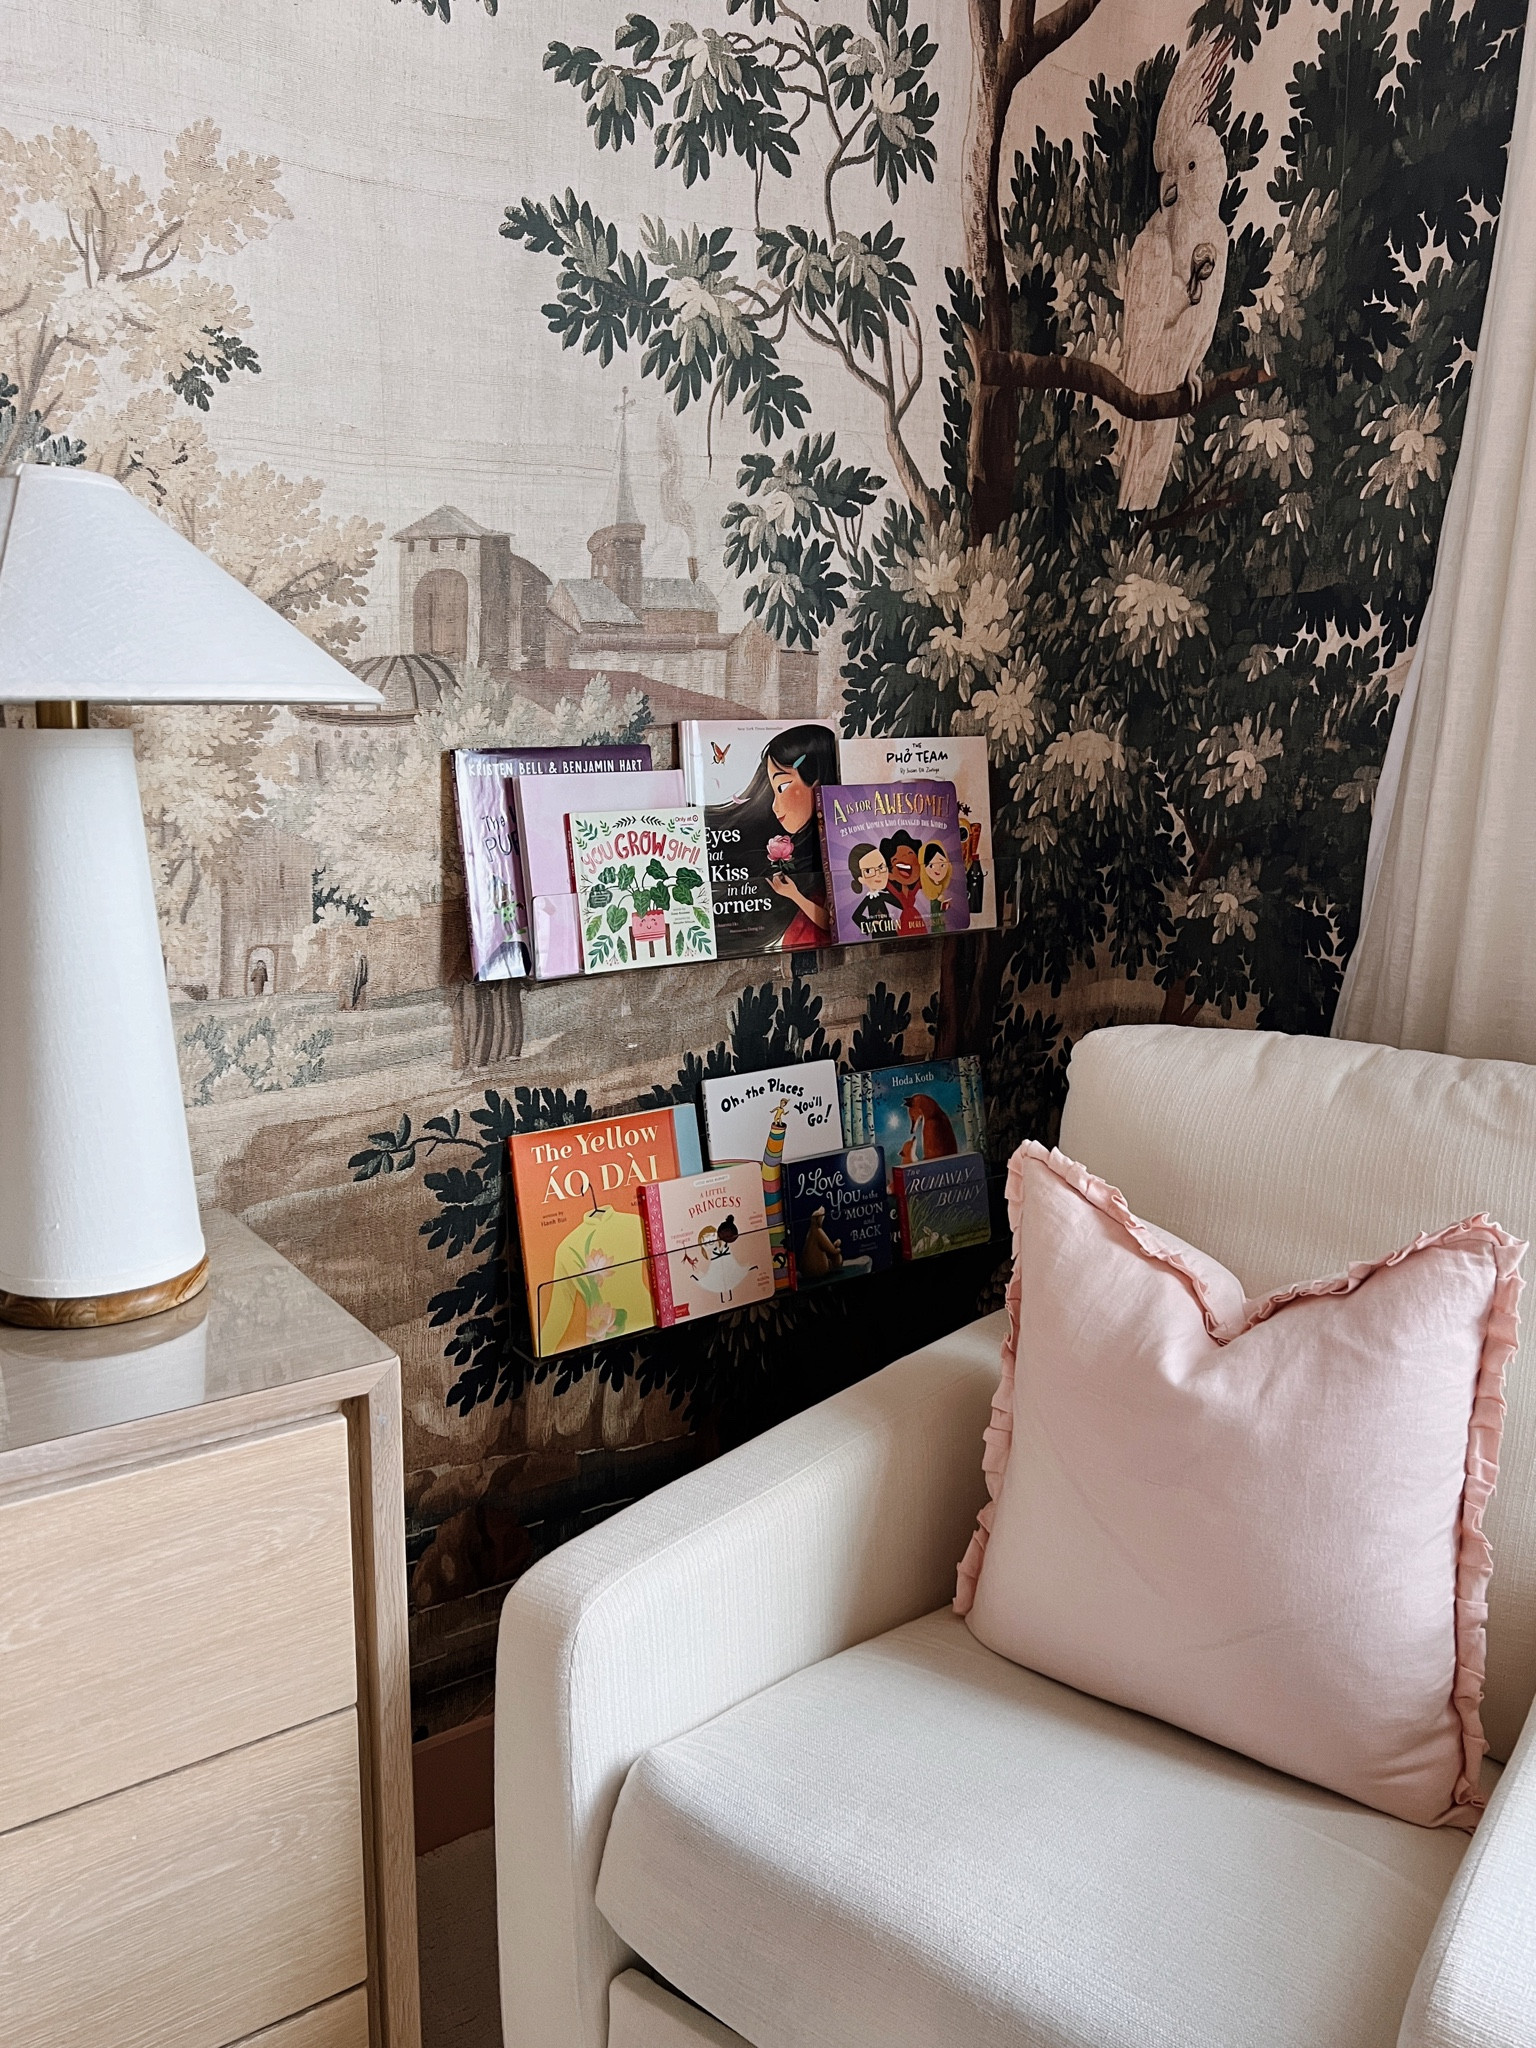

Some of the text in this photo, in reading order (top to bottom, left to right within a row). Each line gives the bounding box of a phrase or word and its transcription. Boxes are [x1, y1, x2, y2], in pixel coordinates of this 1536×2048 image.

[915, 750, 949, 763] TEAM
[468, 759, 643, 778] KRISTEN BELL & BENJAMIN HART
[834, 799, 848, 826] A
[855, 800, 872, 812] FOR
[874, 790, 950, 818] AWESOME!
[711, 864, 749, 882] Kiss
[727, 882, 758, 896] in the
[713, 898, 772, 915] orners
[879, 919, 902, 932] CHEN
[892, 1071, 935, 1087] Hoda Kotb
[721, 1078, 805, 1113] Oh, the Places
[793, 1095, 823, 1114] You'll
[807, 1104, 833, 1127] Go!
[530, 1125, 659, 1164] The Yellow
[541, 1152, 660, 1204] ÁO DÀI
[805, 1167, 846, 1196] Love
[904, 1166, 976, 1195] RUNAWAY
[705, 1186, 727, 1198] LITTLE
[935, 1183, 985, 1207] BUNNY
[688, 1196, 742, 1218] PRINCESS
[845, 1201, 883, 1220] MOON
[850, 1223, 882, 1241] BACK
